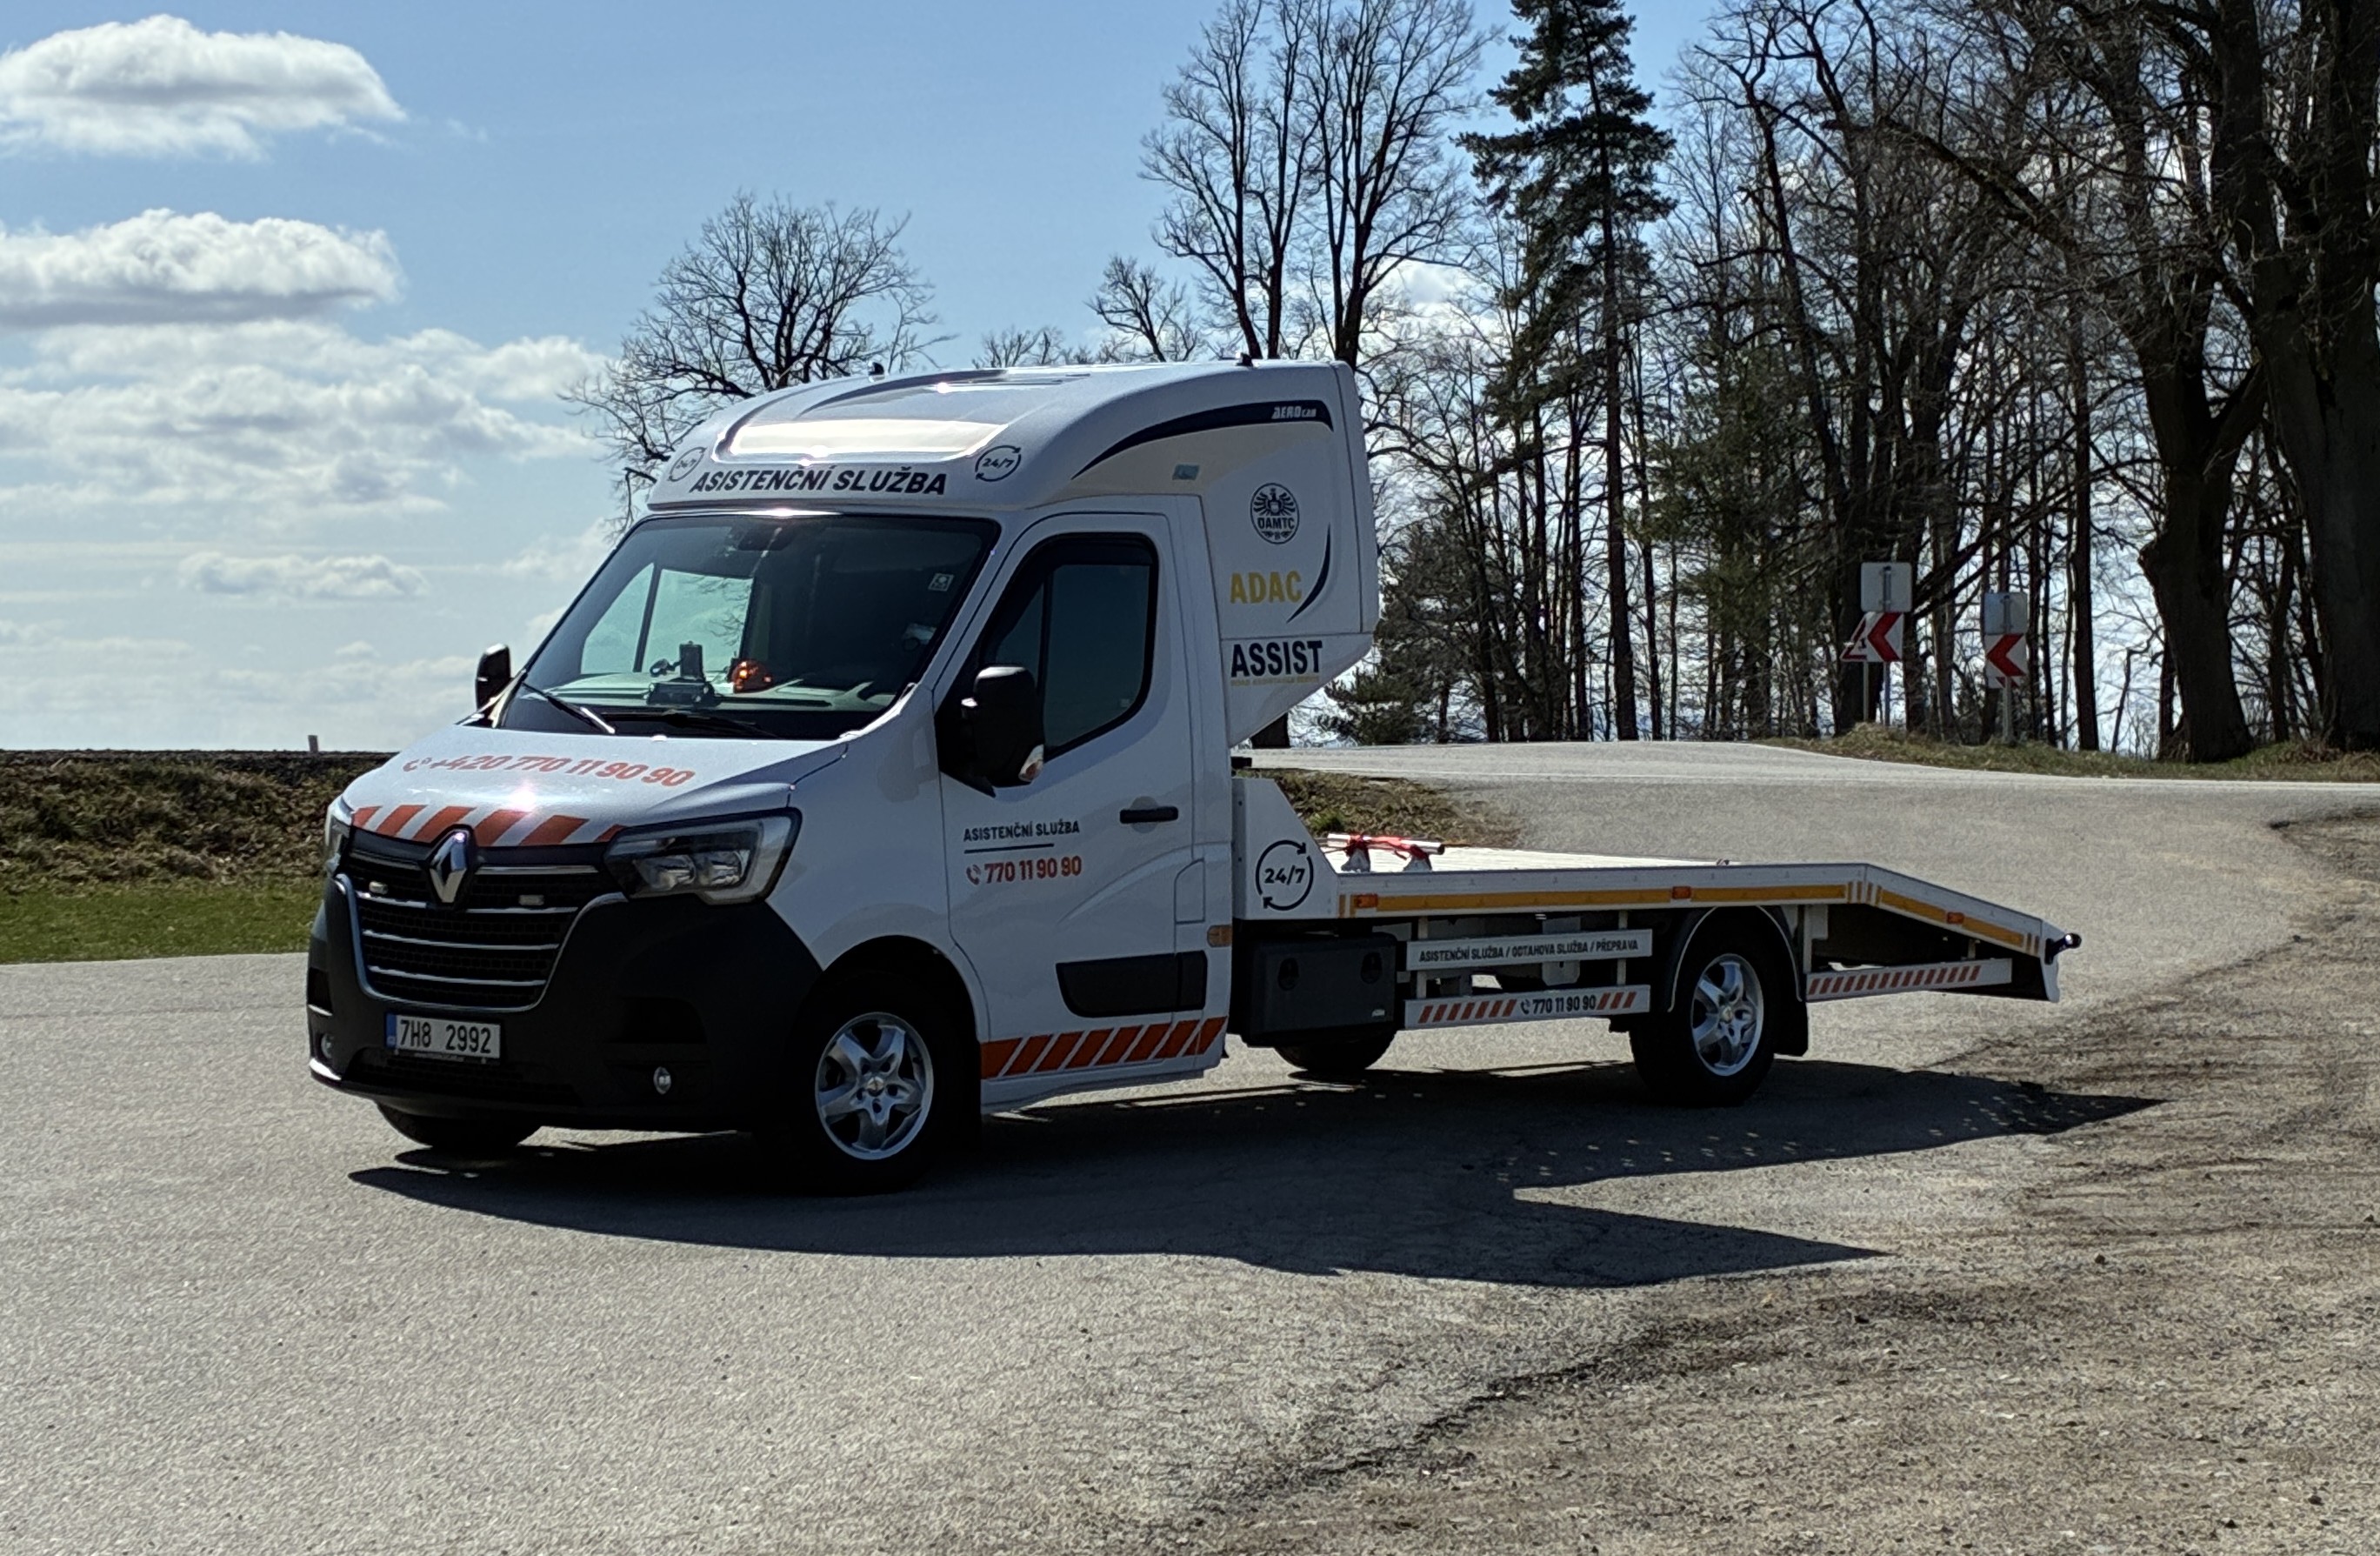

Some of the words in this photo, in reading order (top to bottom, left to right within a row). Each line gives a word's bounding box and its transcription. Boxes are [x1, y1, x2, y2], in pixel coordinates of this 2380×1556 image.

[982, 457, 1016, 470] 24/7
[689, 464, 837, 493] ASISTENČNÍ
[832, 465, 947, 496] SLUŽBA
[1230, 570, 1303, 604] ADAC
[1230, 639, 1323, 678] ASSIST
[430, 755, 513, 771] +420
[503, 756, 573, 772] 770
[565, 759, 607, 775] 11
[595, 762, 650, 780] 90
[641, 767, 696, 787] 90
[963, 821, 1033, 842] ASISTENČNÍ
[1035, 818, 1080, 836] SLUŽBA
[983, 861, 1016, 884] 770
[1018, 859, 1033, 880] 11
[1037, 858, 1057, 879] 90
[1061, 855, 1083, 878] 90
[1264, 865, 1305, 885] 24/7
[1419, 946, 1470, 963] ASISTENČNÍ
[1471, 945, 1503, 960] SLUŽBA
[1505, 945, 1511, 958] /
[1557, 940, 1589, 955] SLUŽBA
[1590, 940, 1596, 953] /
[1596, 938, 1639, 952] PŘEPRAVA
[1532, 998, 1553, 1015] 770
[1555, 997, 1564, 1012] 11
[1566, 996, 1580, 1012] 90
[1583, 994, 1597, 1011] 90
[400, 1018, 432, 1048] 7H8
[445, 1025, 491, 1054] 2992
